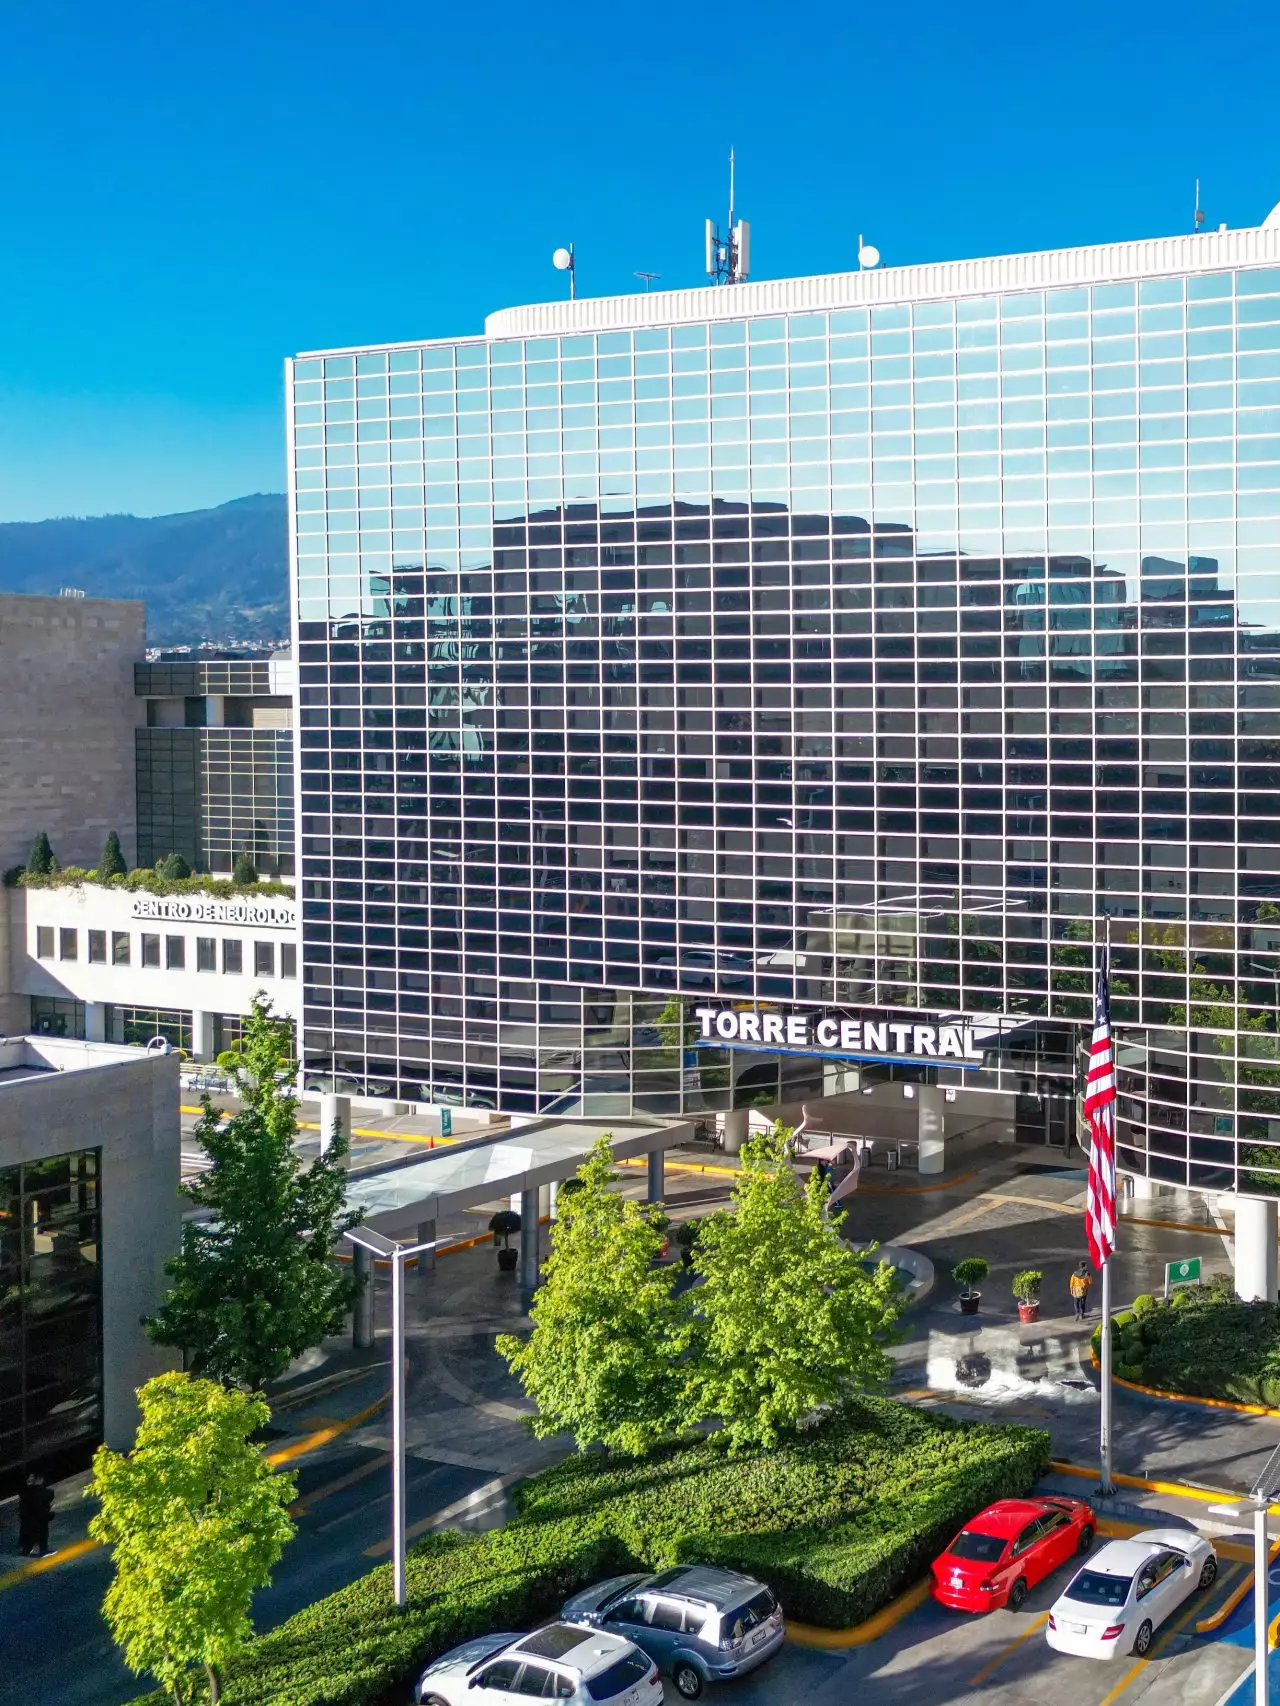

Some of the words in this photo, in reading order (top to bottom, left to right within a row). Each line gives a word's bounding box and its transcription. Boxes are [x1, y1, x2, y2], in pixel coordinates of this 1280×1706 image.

[133, 900, 192, 918] CENTRO
[194, 904, 212, 919] DE
[695, 1008, 808, 1045] TORRE
[816, 1019, 984, 1059] CENTRAL
